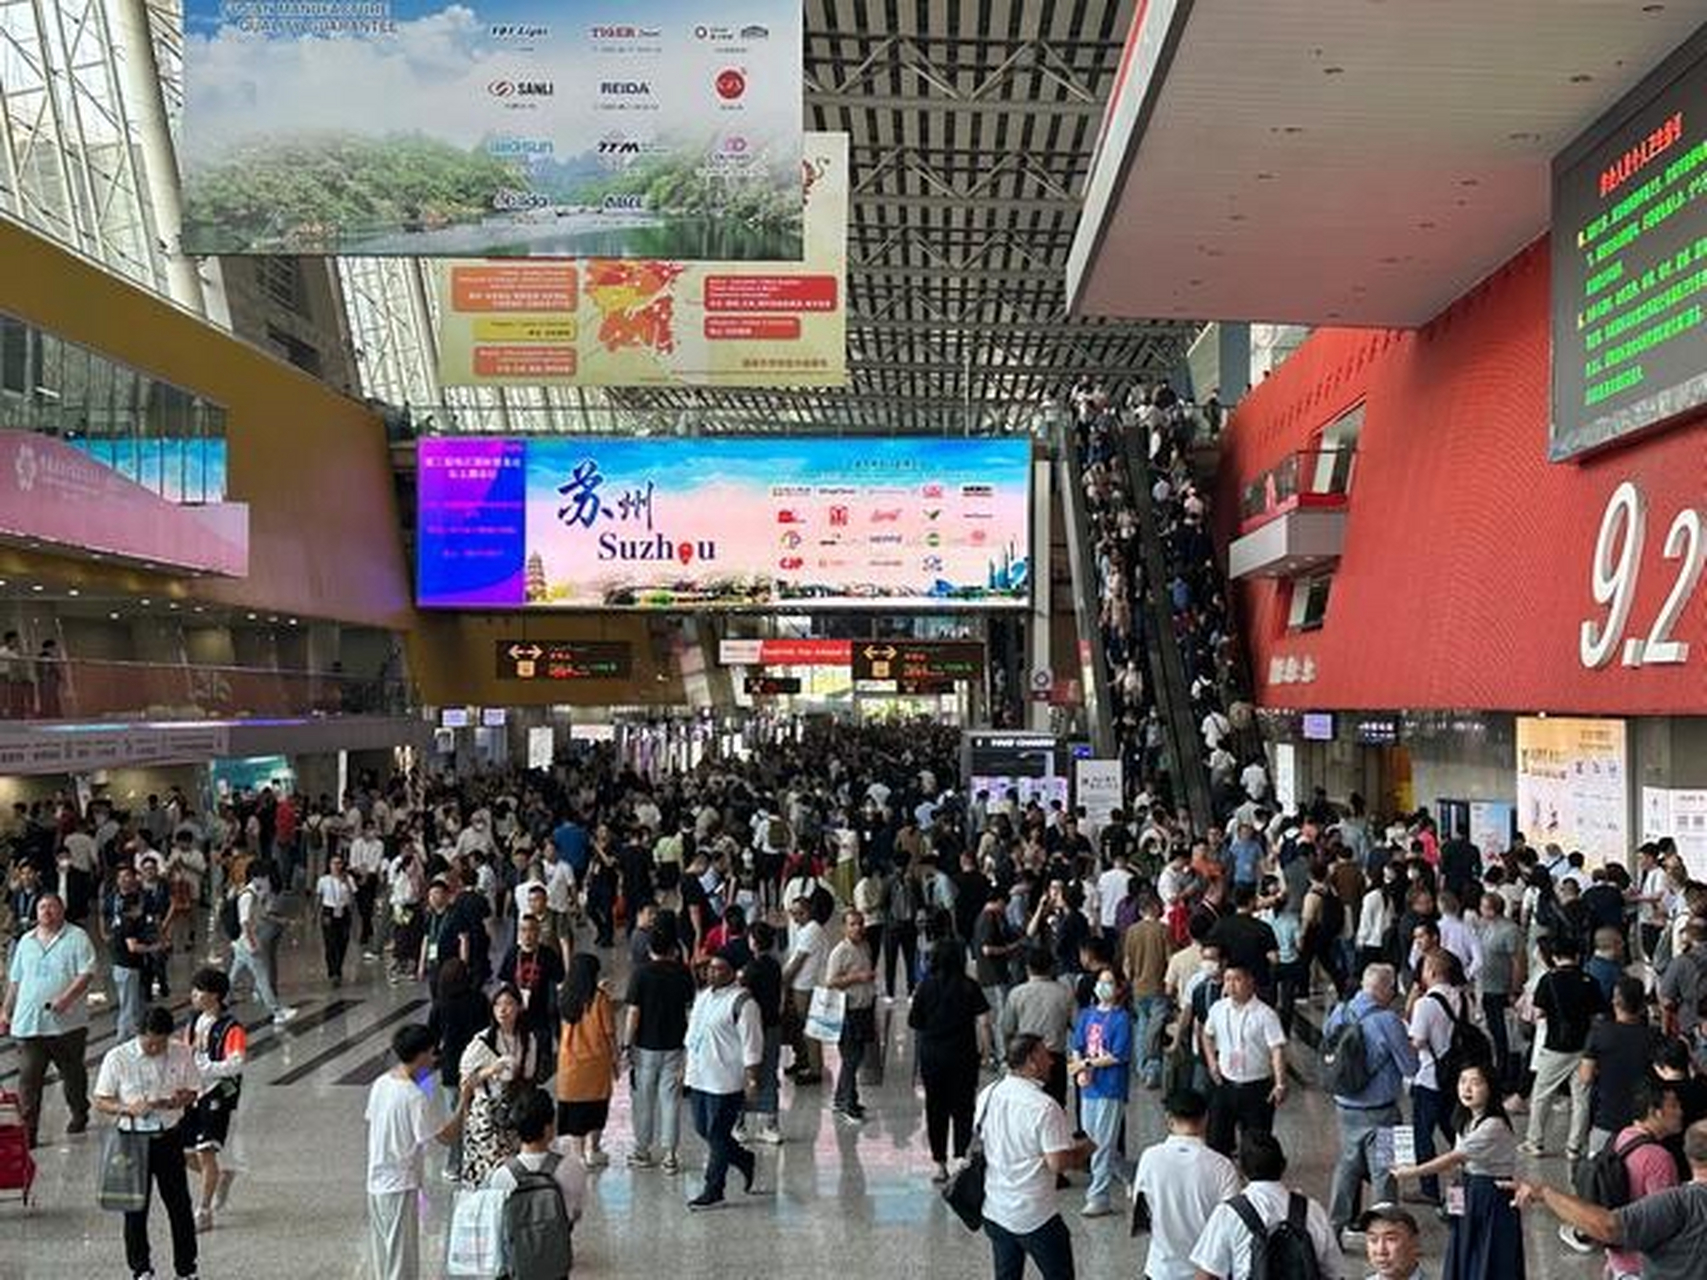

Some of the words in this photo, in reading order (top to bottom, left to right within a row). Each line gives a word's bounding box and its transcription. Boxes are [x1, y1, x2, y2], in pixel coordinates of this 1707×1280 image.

[592, 27, 635, 38] TIGER
[517, 81, 554, 96] SANLI
[600, 81, 650, 95] REIDA
[558, 460, 655, 531] 苏州
[1580, 481, 1704, 668] 9.2
